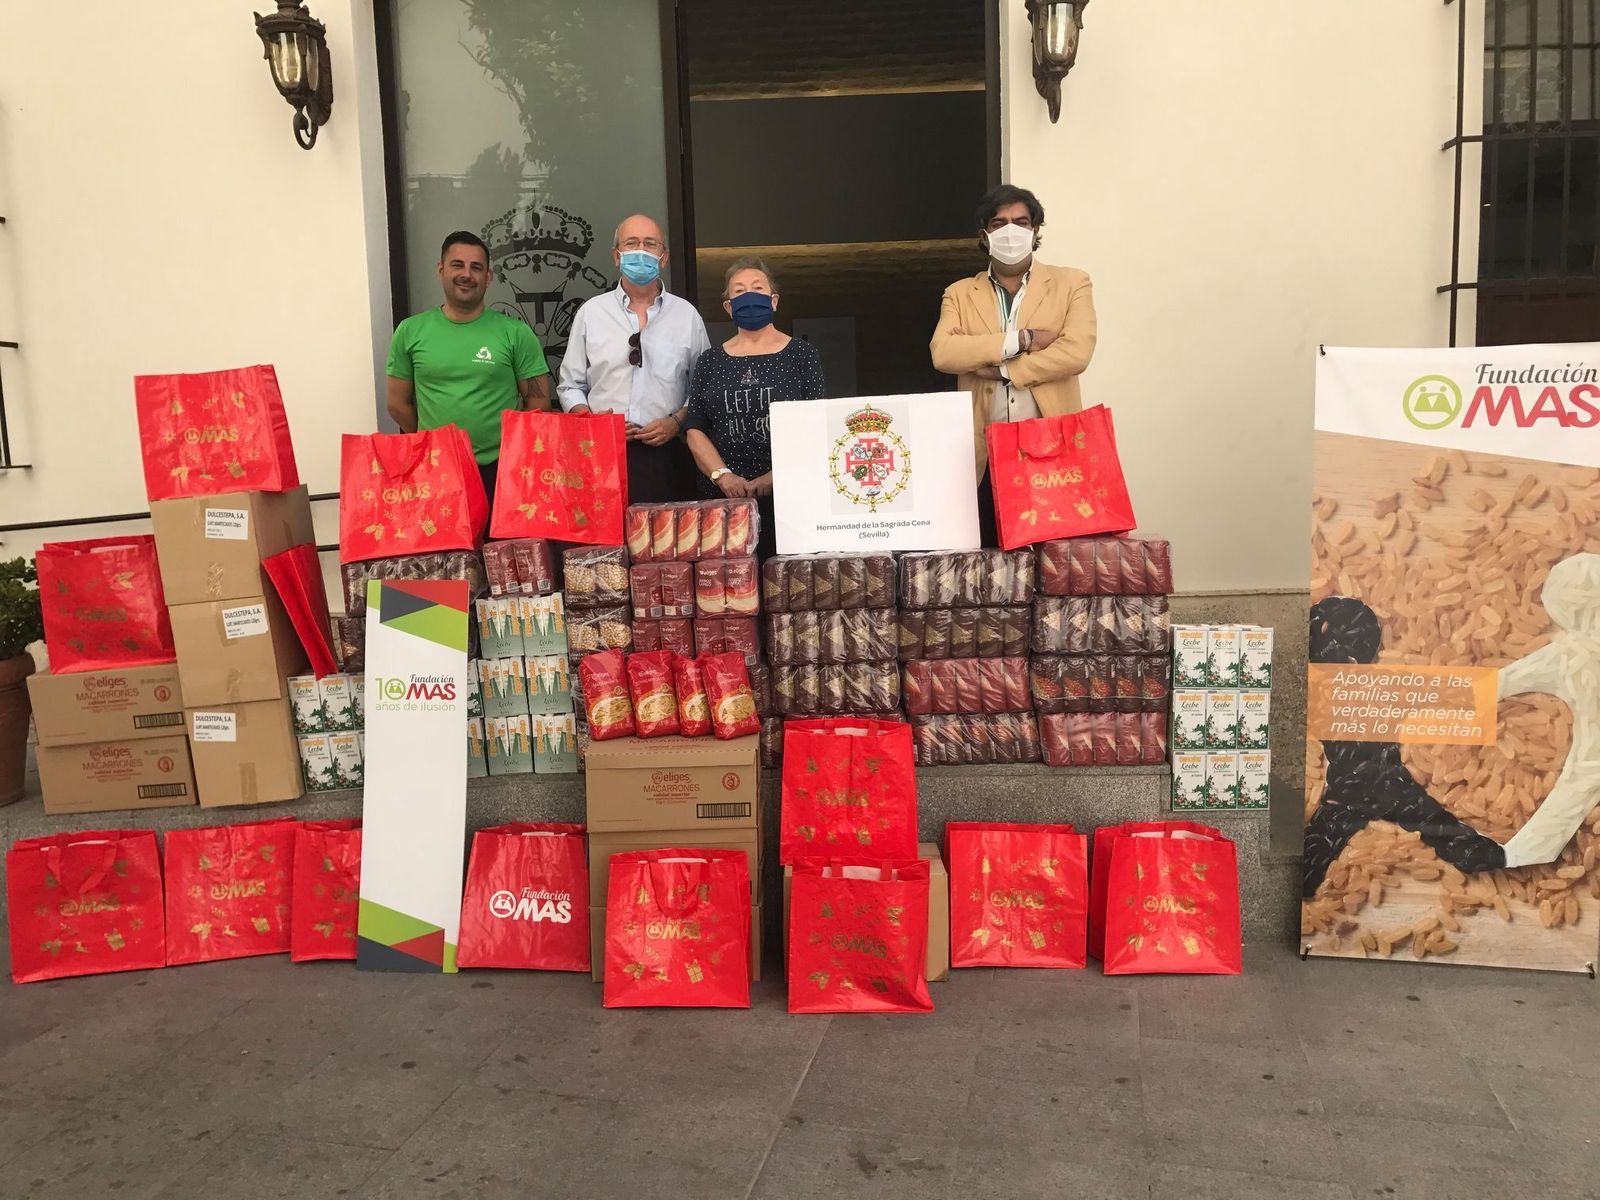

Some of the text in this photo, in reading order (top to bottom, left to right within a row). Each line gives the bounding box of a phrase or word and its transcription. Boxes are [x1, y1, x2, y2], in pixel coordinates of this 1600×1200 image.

[1476, 362, 1598, 384] Fundación
[724, 386, 774, 413] LET IT
[1460, 384, 1600, 428] MAS
[200, 430, 239, 444] MAS
[1046, 470, 1083, 488] MAS
[816, 522, 861, 531] Hermandad
[880, 520, 910, 530] Sagrada
[858, 531, 890, 540] (Sevilla)
[96, 676, 128, 688] eliges
[410, 674, 454, 683] Fundación
[1331, 672, 1472, 688] Apoyando a las
[76, 688, 140, 701] MACARRONES
[406, 683, 456, 700] MAS
[1332, 687, 1439, 705] familias que
[376, 701, 456, 711] años de ilusión
[1332, 704, 1476, 720] verdaderamente
[1330, 720, 1482, 737] más lo necesitan
[102, 747, 133, 758] eliges
[82, 758, 143, 770] MACARRONES
[1244, 762, 1262, 770] Leche
[664, 772, 692, 784] eliges
[643, 784, 700, 793] MACARRONES
[521, 887, 571, 901] Fundación
[513, 898, 571, 924] MAS
